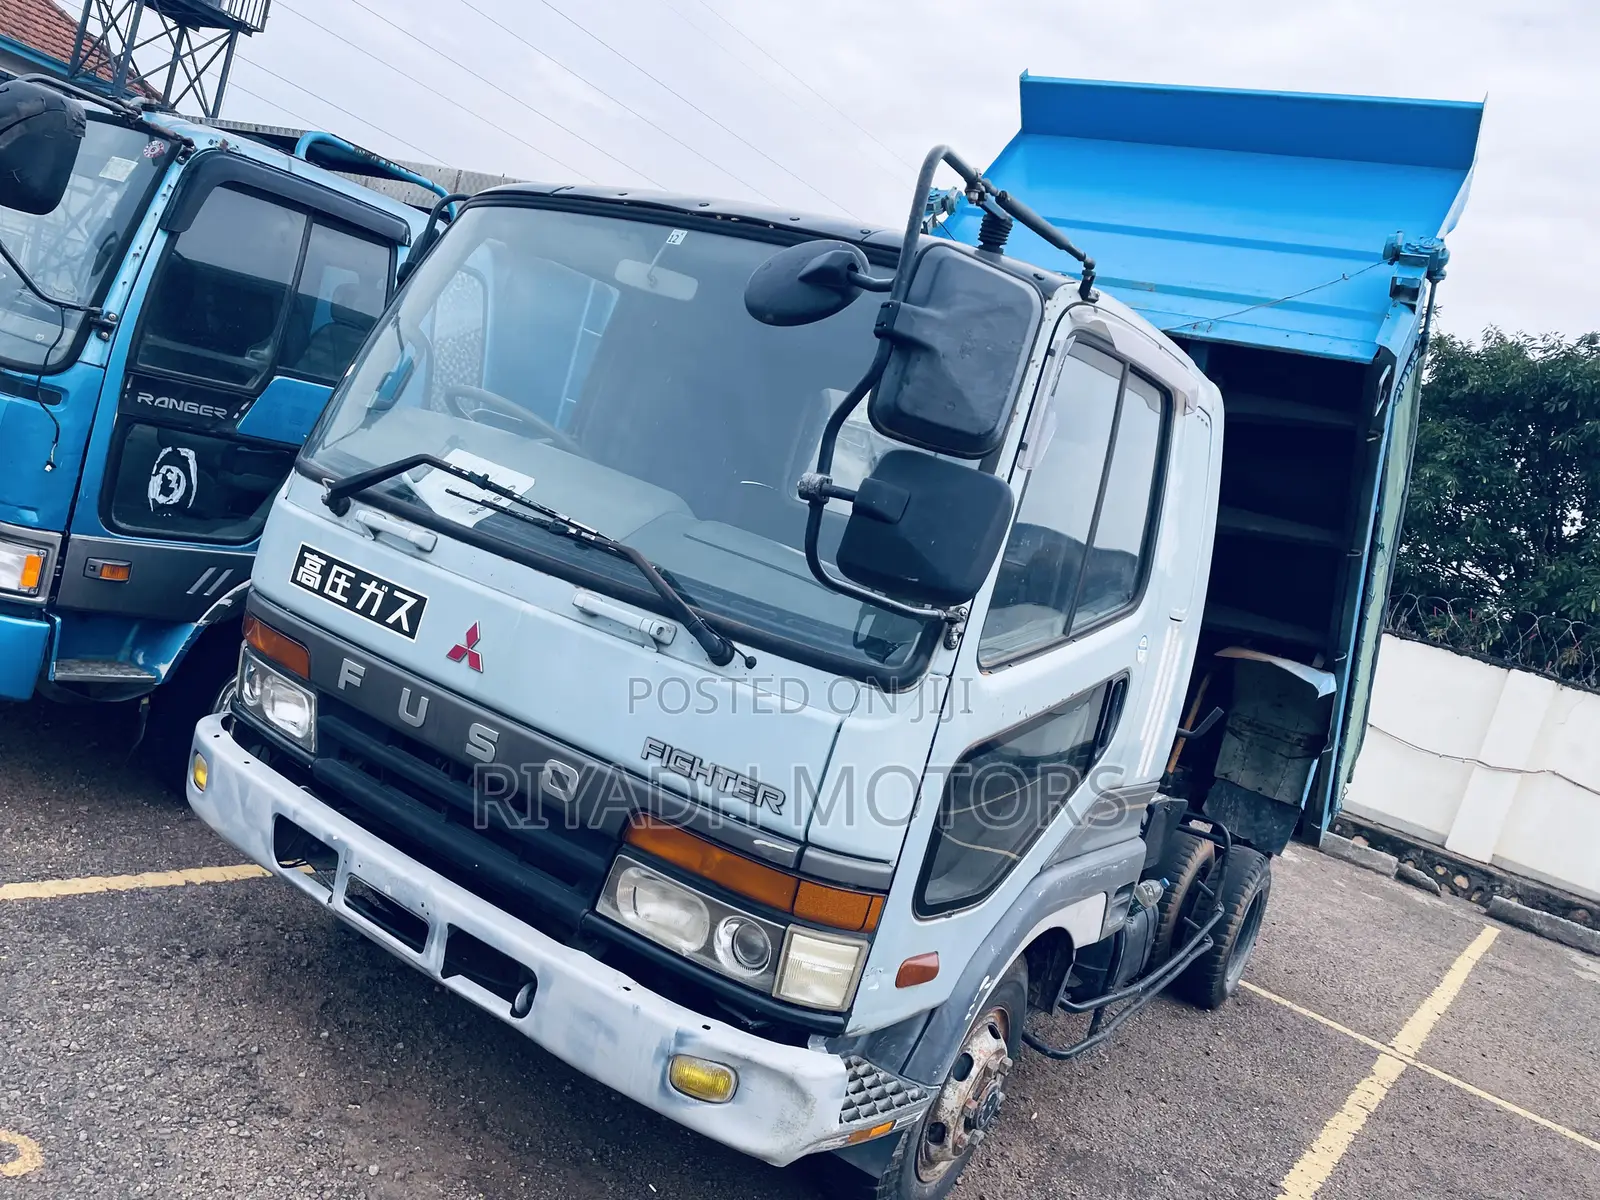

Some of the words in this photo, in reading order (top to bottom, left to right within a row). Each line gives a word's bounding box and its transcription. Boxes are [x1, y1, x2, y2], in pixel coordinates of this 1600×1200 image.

[137, 392, 228, 420] RANGER
[296, 551, 419, 633] 高圧ガス
[337, 657, 580, 803] FUSO
[640, 736, 786, 816] FIGHTER
